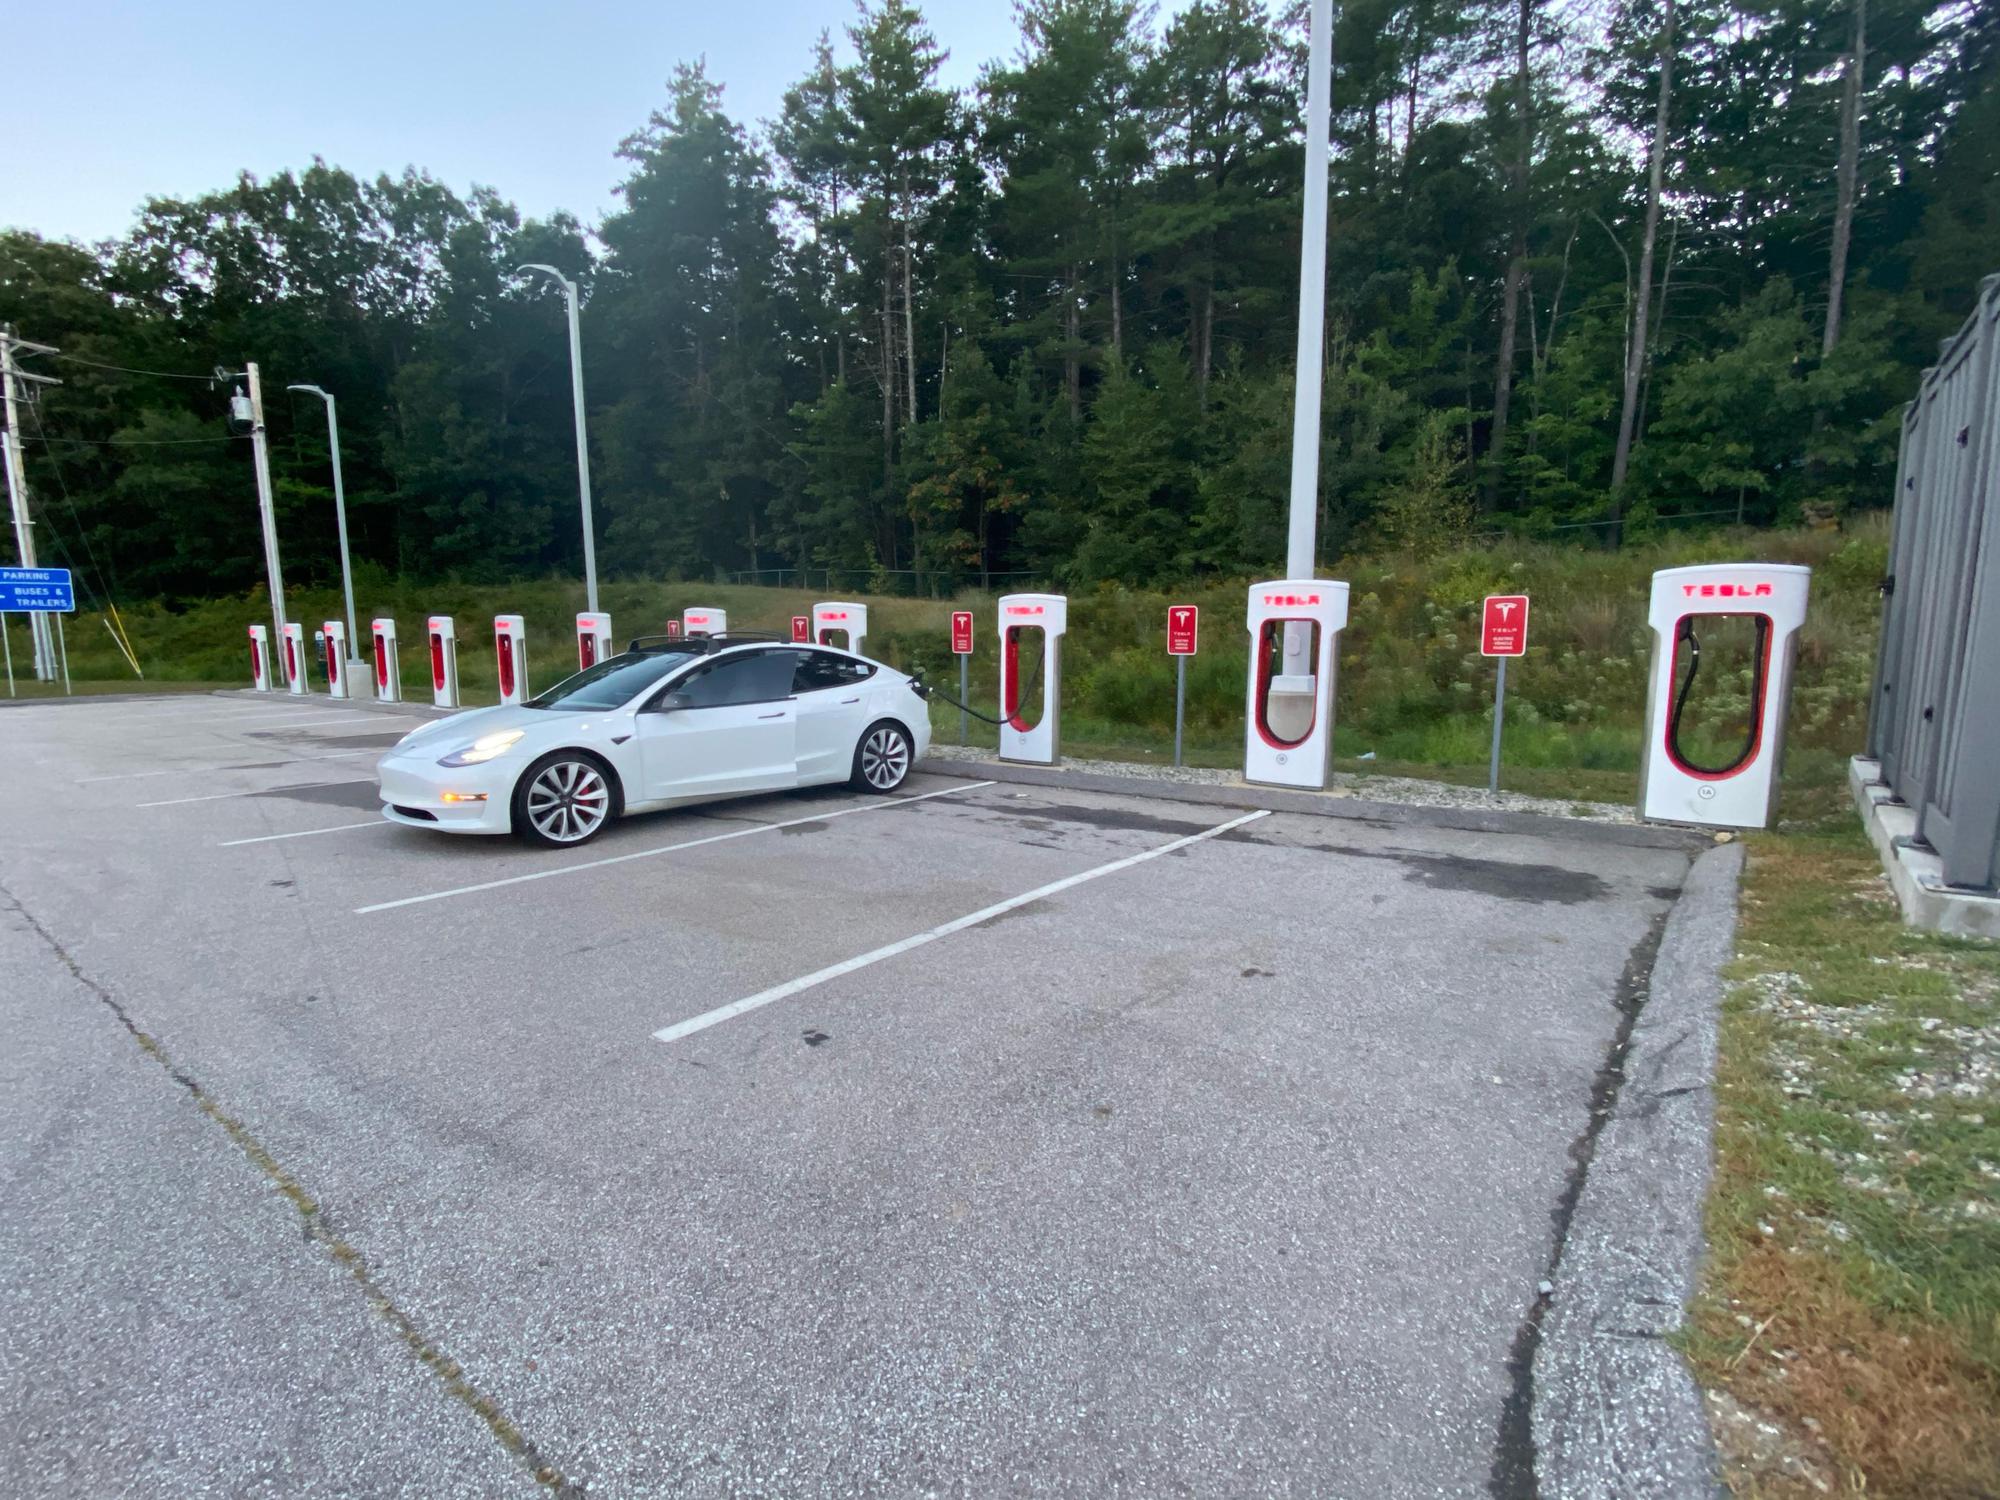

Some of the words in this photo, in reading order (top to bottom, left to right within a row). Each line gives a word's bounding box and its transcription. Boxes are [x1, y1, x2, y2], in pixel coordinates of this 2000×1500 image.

[3, 572, 50, 580] PARKING
[14, 587, 50, 596] BUSES
[1682, 583, 1774, 597] TESLA
[16, 598, 68, 607] TRAILERS
[1264, 595, 1320, 606] TESLA
